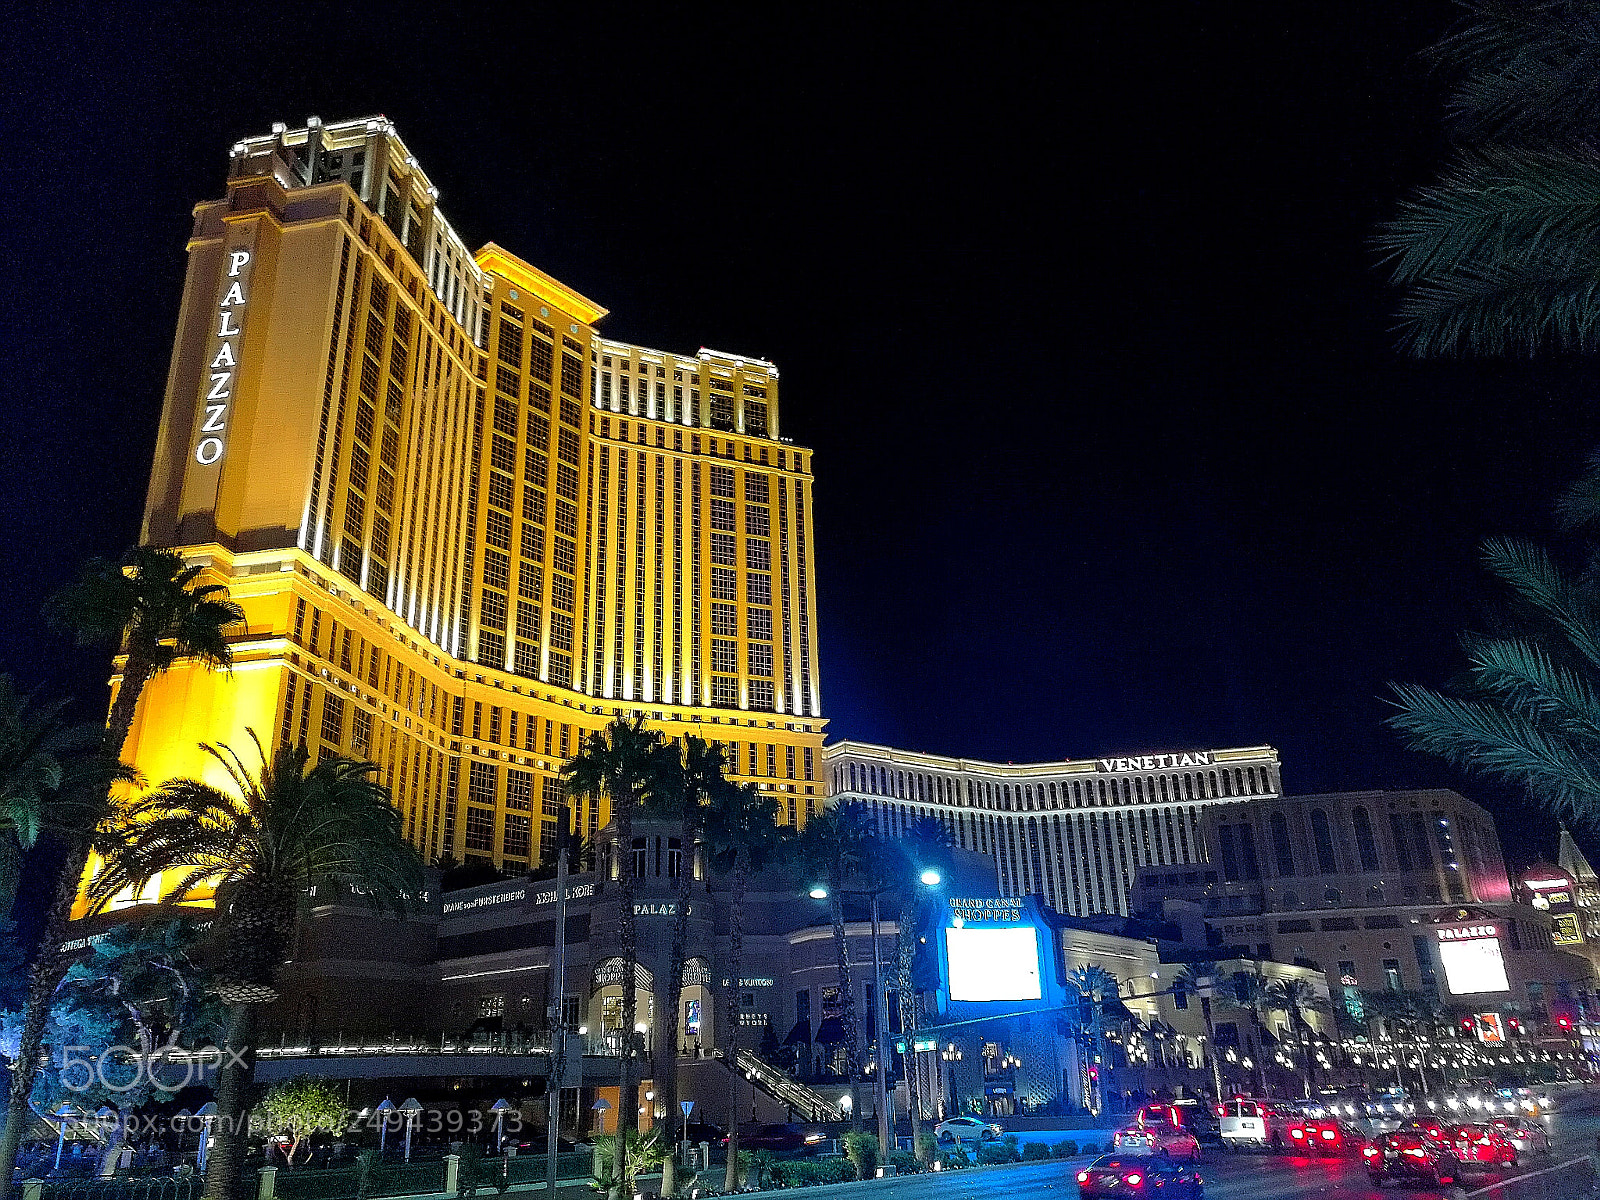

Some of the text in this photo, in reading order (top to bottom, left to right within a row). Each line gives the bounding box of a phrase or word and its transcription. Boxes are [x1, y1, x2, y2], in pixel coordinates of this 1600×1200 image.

[196, 251, 250, 465] PALAZZO
[1100, 751, 1210, 772] VENETIAN
[949, 898, 1024, 908] GRAND CANAL
[633, 904, 692, 916] PALAZ
[954, 909, 1021, 921] SHOPPES
[1437, 925, 1496, 940] PALAZZO
